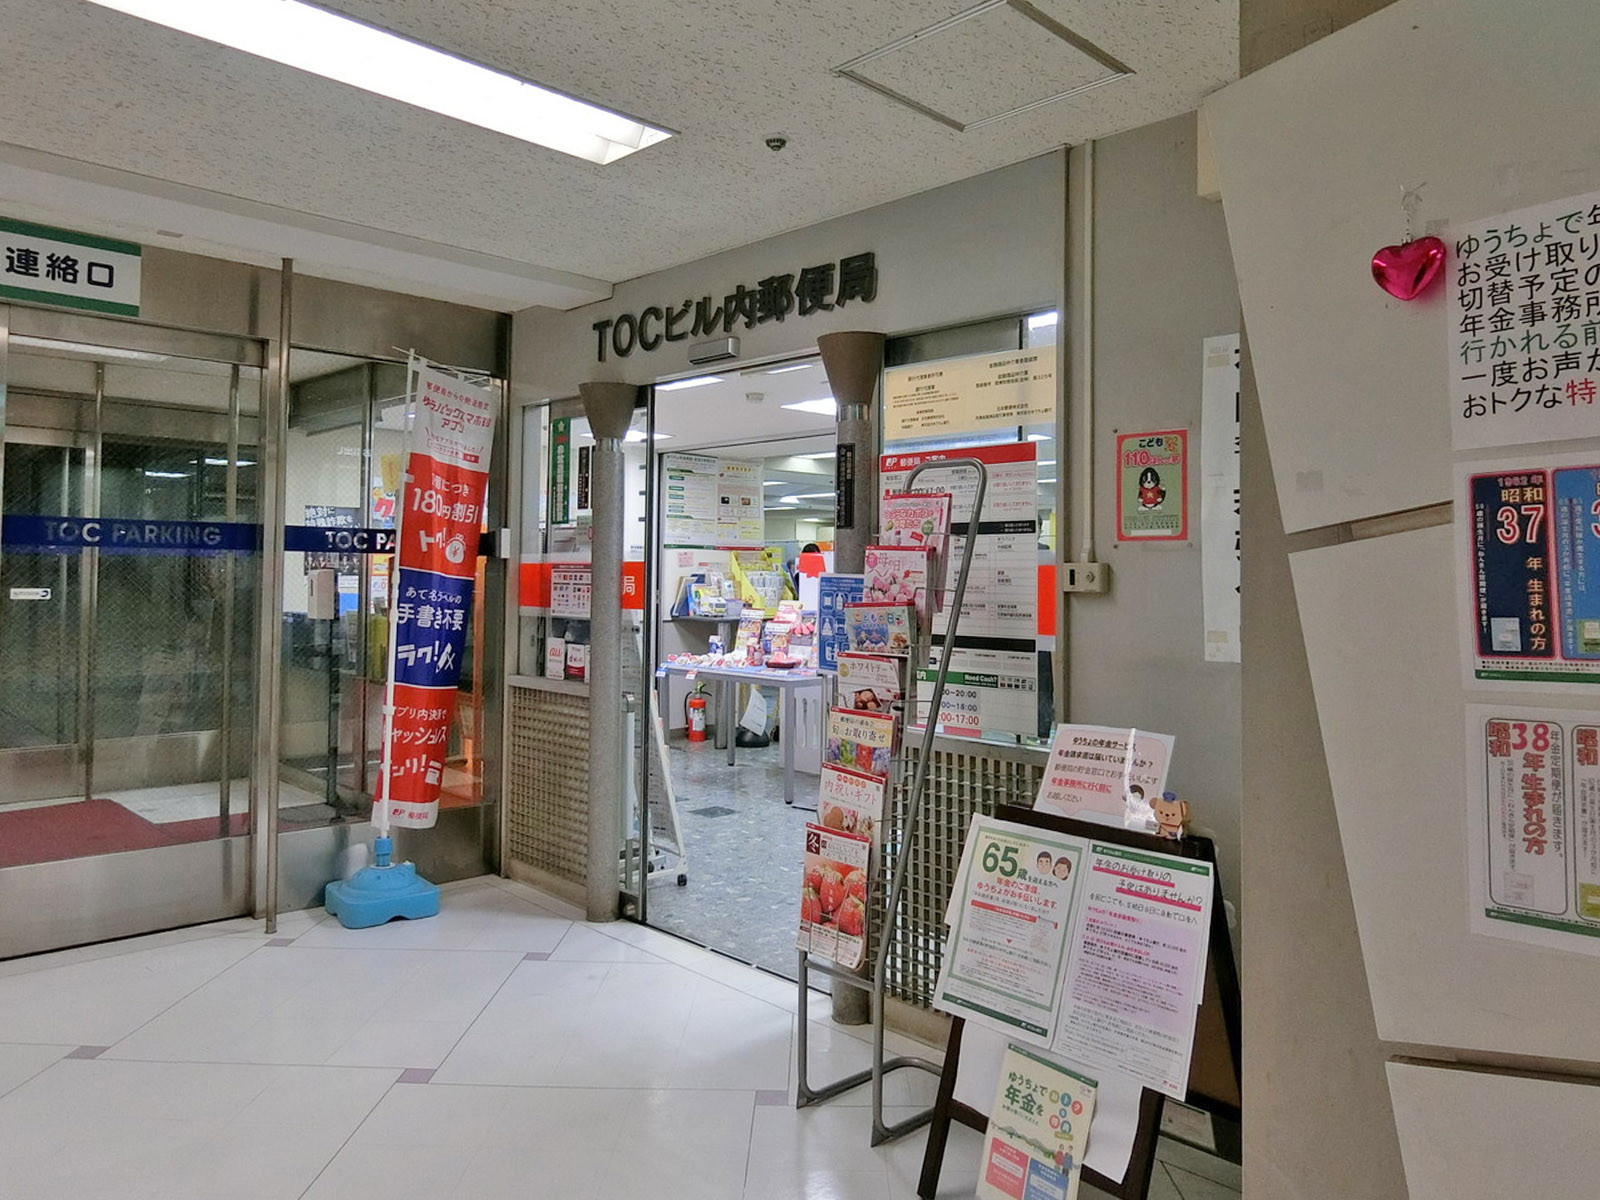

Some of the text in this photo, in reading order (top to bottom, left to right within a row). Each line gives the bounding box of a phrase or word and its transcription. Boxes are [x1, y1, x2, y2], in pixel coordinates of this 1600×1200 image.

[6, 247, 114, 288] 連絡口
[592, 252, 878, 362] TOCビル内郵便局
[1463, 377, 1597, 419] おトクな特
[1138, 437, 1164, 448] こども
[412, 486, 480, 525] 180円割引
[1501, 487, 1544, 503] 昭和
[46, 521, 223, 545] TOC PARKING
[1496, 504, 1545, 544] 37
[325, 530, 369, 550] TOC
[1511, 722, 1550, 751] 38
[1058, 748, 1154, 769] 年金請求書は届いていまんか?
[808, 833, 820, 853] 冬
[1008, 1071, 1048, 1098] ゆうちょで
[1004, 1084, 1045, 1118] 年金を
